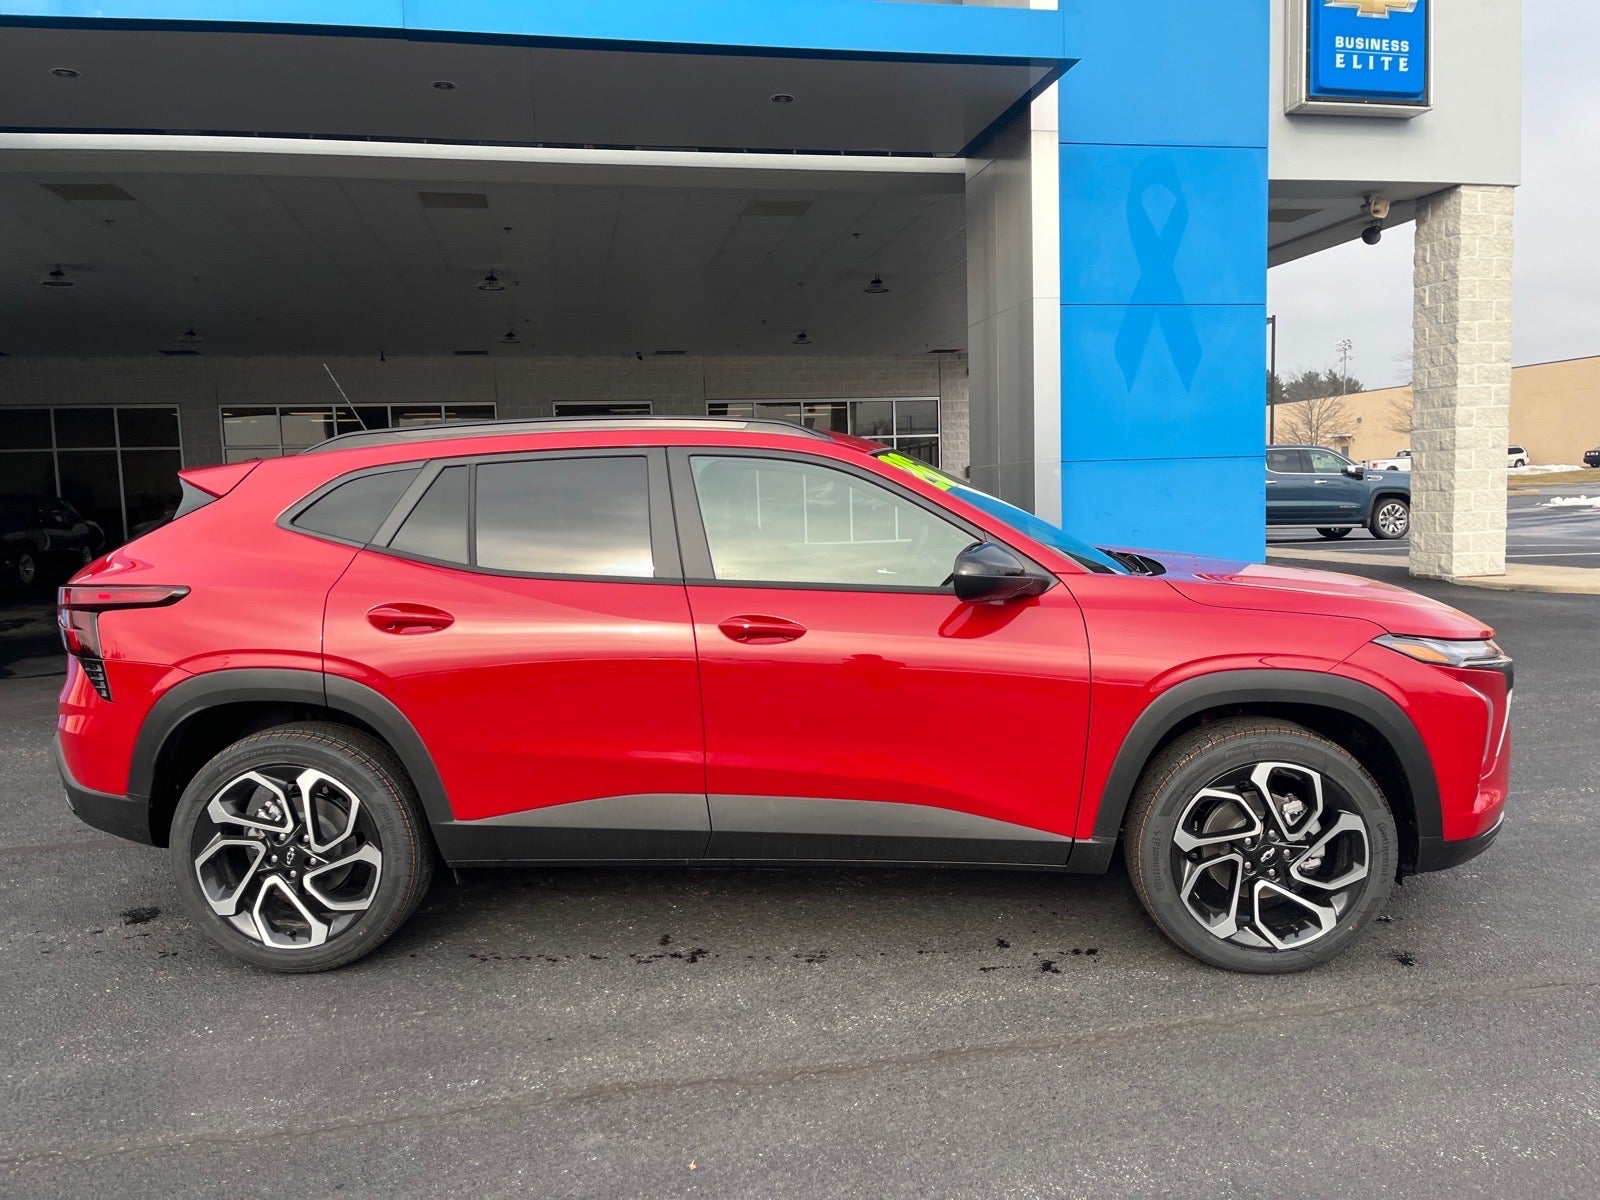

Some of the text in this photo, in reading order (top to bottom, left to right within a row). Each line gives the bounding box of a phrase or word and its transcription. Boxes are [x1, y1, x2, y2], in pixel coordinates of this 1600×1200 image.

[1335, 35, 1410, 53] BUSINESS
[1335, 53, 1409, 72] ELITE
[1152, 837, 1165, 892] Continental
[1376, 822, 1390, 876] Continental
